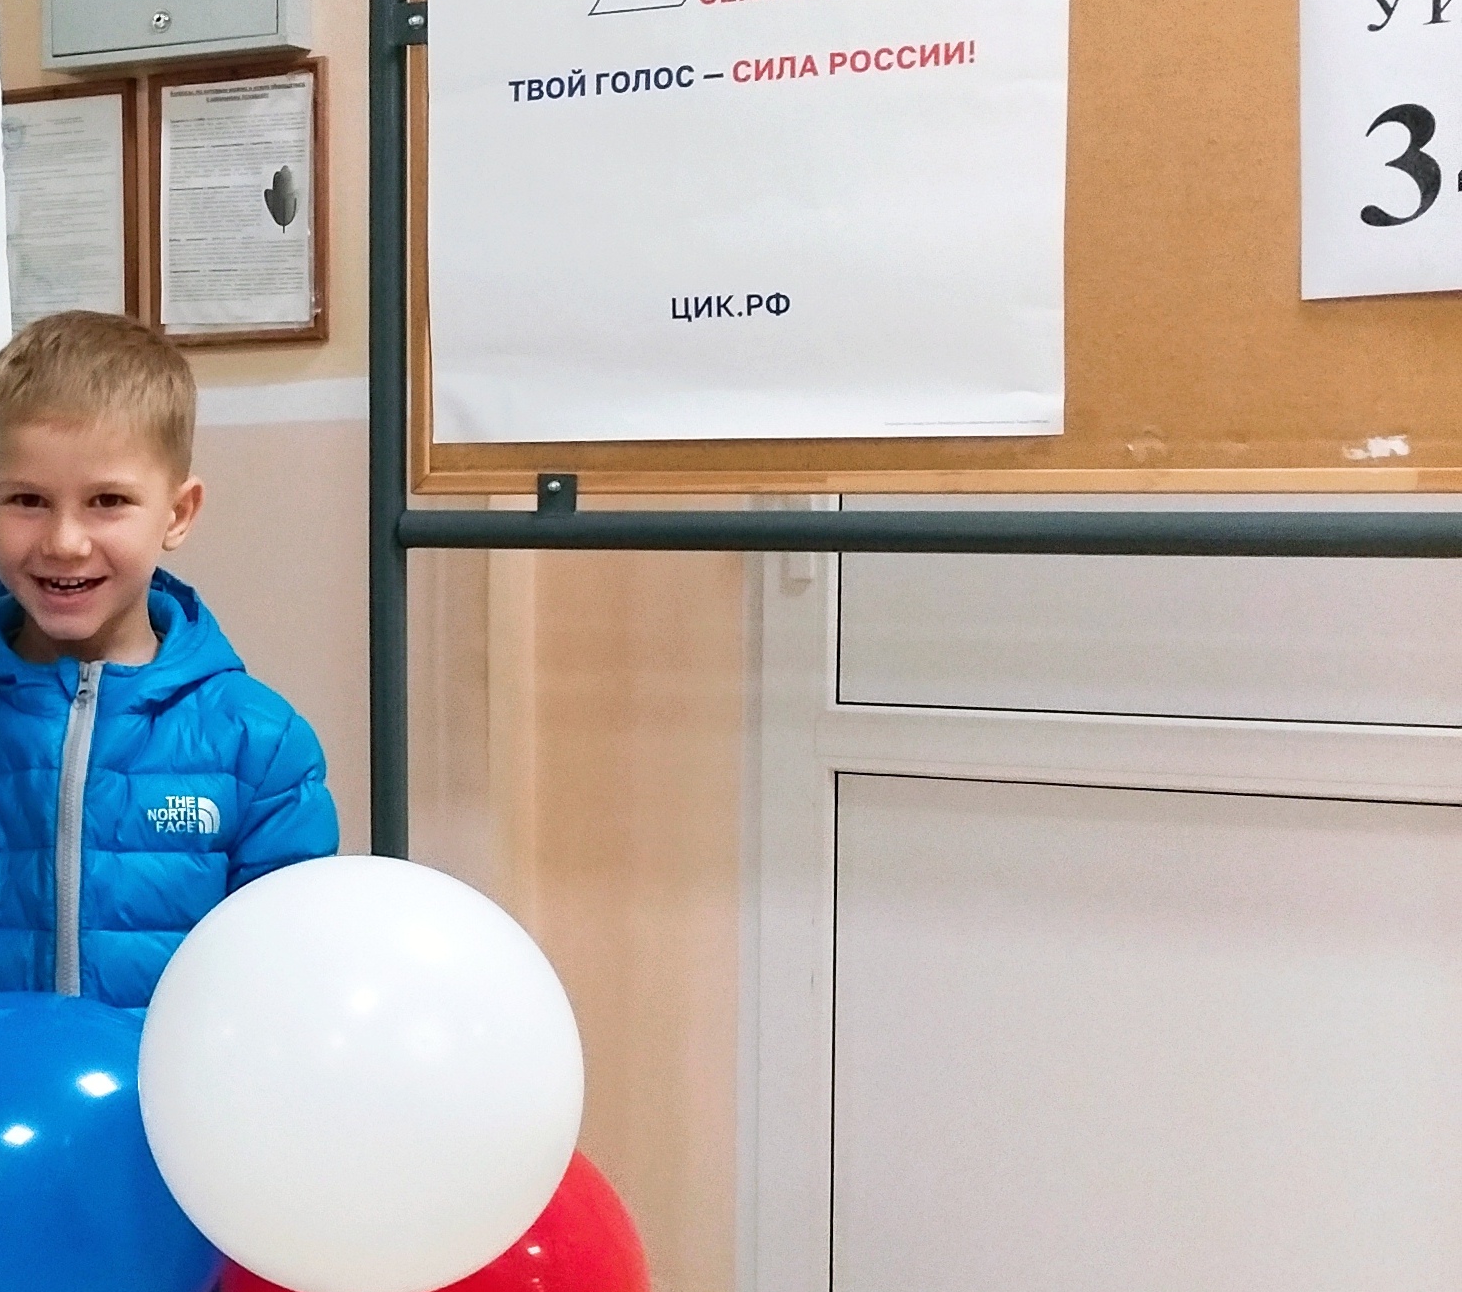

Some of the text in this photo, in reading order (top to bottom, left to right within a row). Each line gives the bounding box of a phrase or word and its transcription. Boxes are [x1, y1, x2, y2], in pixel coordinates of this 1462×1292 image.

[509, 69, 586, 103] ТВОЙ
[596, 64, 695, 96] ГОЛОС
[733, 55, 819, 84] СИЛА
[829, 40, 976, 74] РОССИИ!
[1360, 103, 1462, 228] 3
[671, 292, 791, 322] ЦИК.РФ
[165, 796, 196, 808] THE
[147, 808, 196, 821] NORTH
[156, 821, 196, 833] FACE
